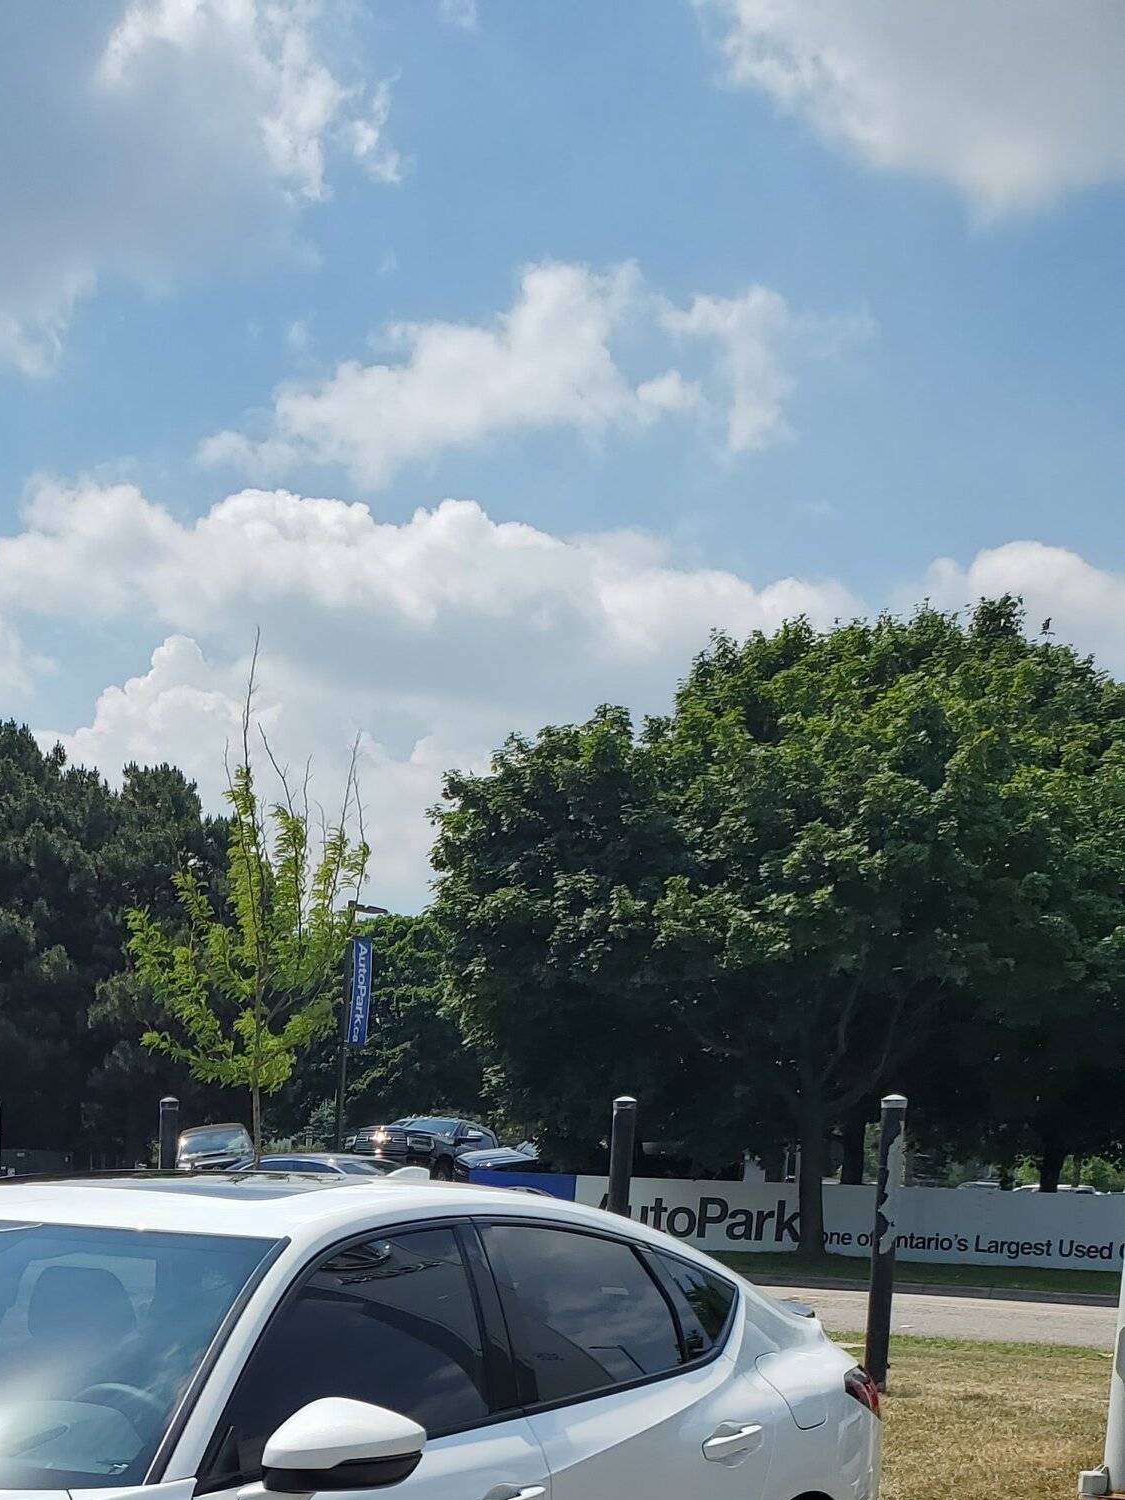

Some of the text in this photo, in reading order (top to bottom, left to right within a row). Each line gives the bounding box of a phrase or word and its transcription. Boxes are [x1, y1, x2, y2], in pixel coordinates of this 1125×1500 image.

[352, 942, 368, 1043] AutoPark.ca
[895, 1232, 969, 1252] ntario's
[975, 1234, 1053, 1260] Largest
[1058, 1239, 1113, 1260] Used
